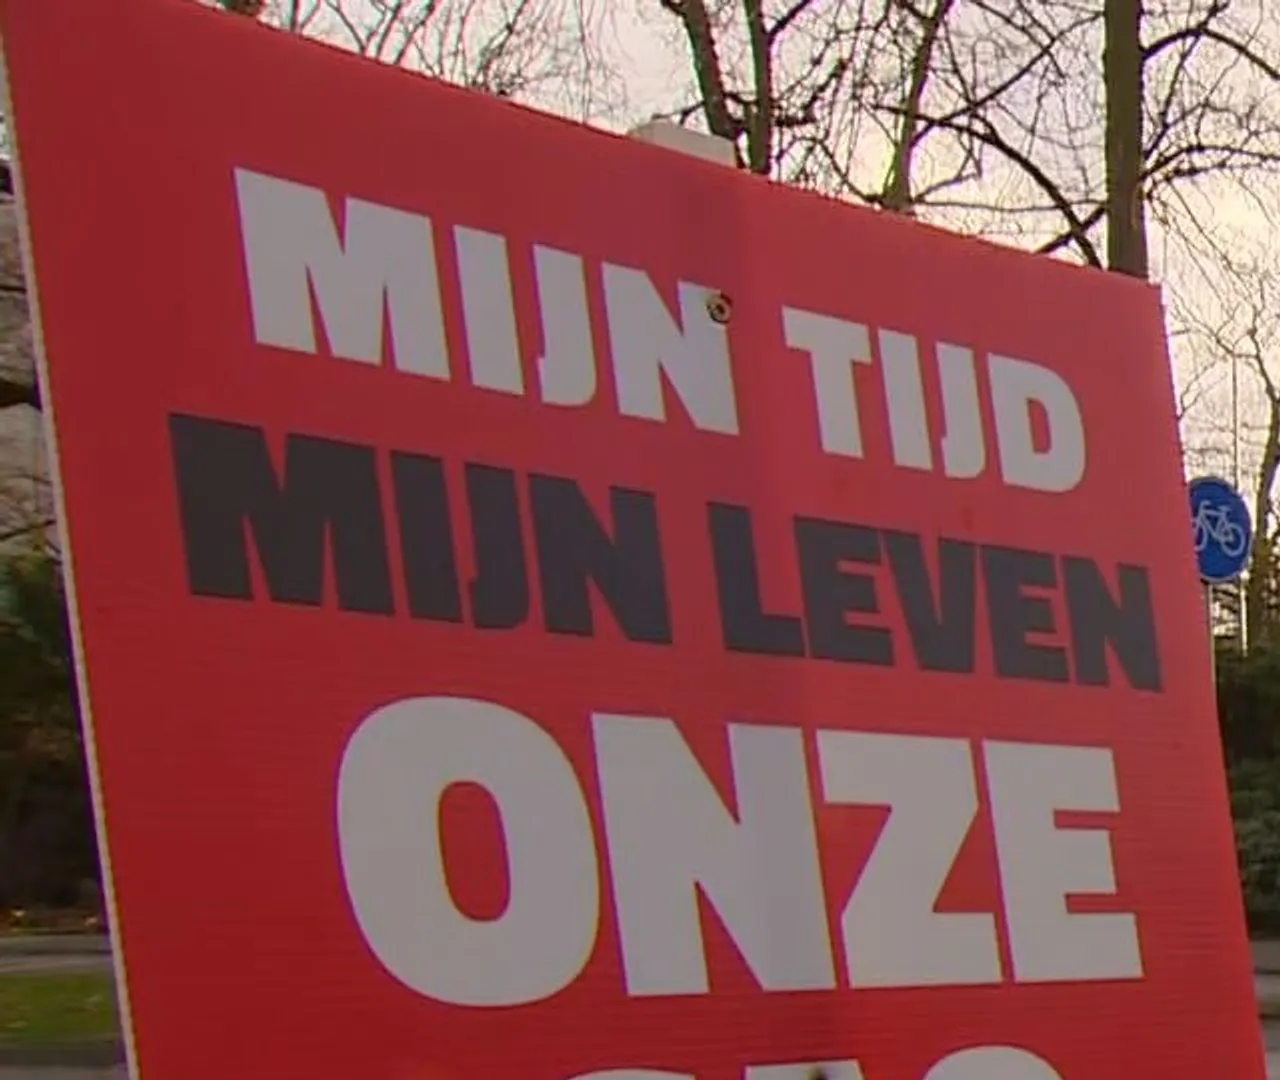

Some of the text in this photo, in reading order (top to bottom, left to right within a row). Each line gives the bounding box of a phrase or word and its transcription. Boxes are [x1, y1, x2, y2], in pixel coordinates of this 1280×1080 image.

[233, 167, 1086, 493] MIJN TIJD
[168, 412, 1164, 693] MIJN LEVEN
[335, 695, 1145, 1007] ONZE
